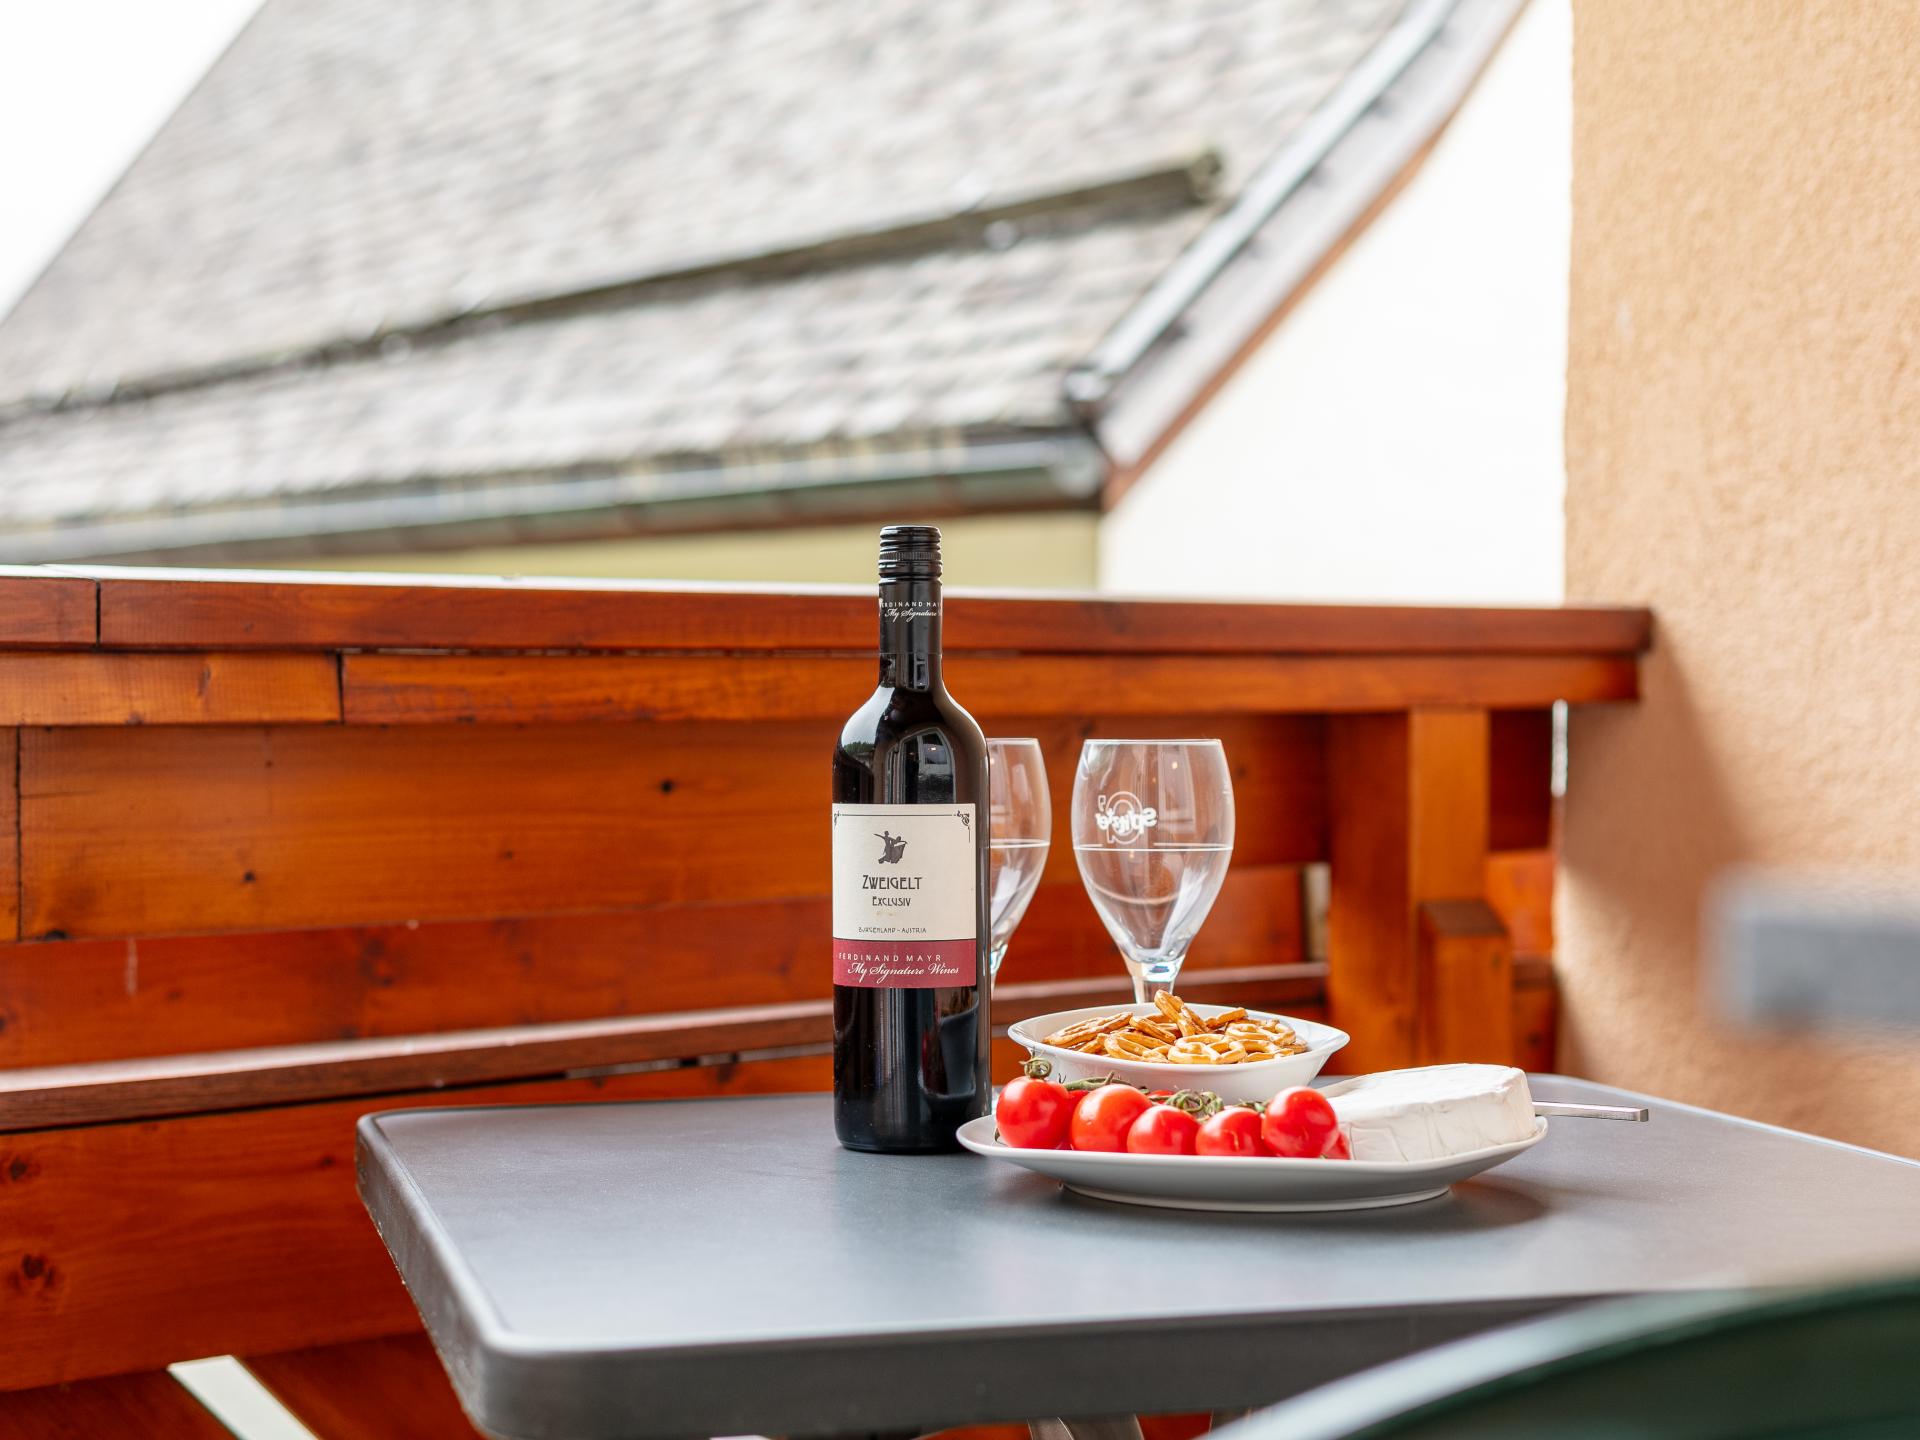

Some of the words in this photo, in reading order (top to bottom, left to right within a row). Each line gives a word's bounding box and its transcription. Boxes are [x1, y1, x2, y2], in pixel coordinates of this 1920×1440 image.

[884, 607, 900, 623] My
[900, 607, 937, 623] Signature
[838, 952, 899, 962] FERDINAND
[906, 954, 941, 962] MAYR
[847, 962, 868, 984] My
[869, 963, 925, 984] Signature
[927, 962, 960, 975] Wines
